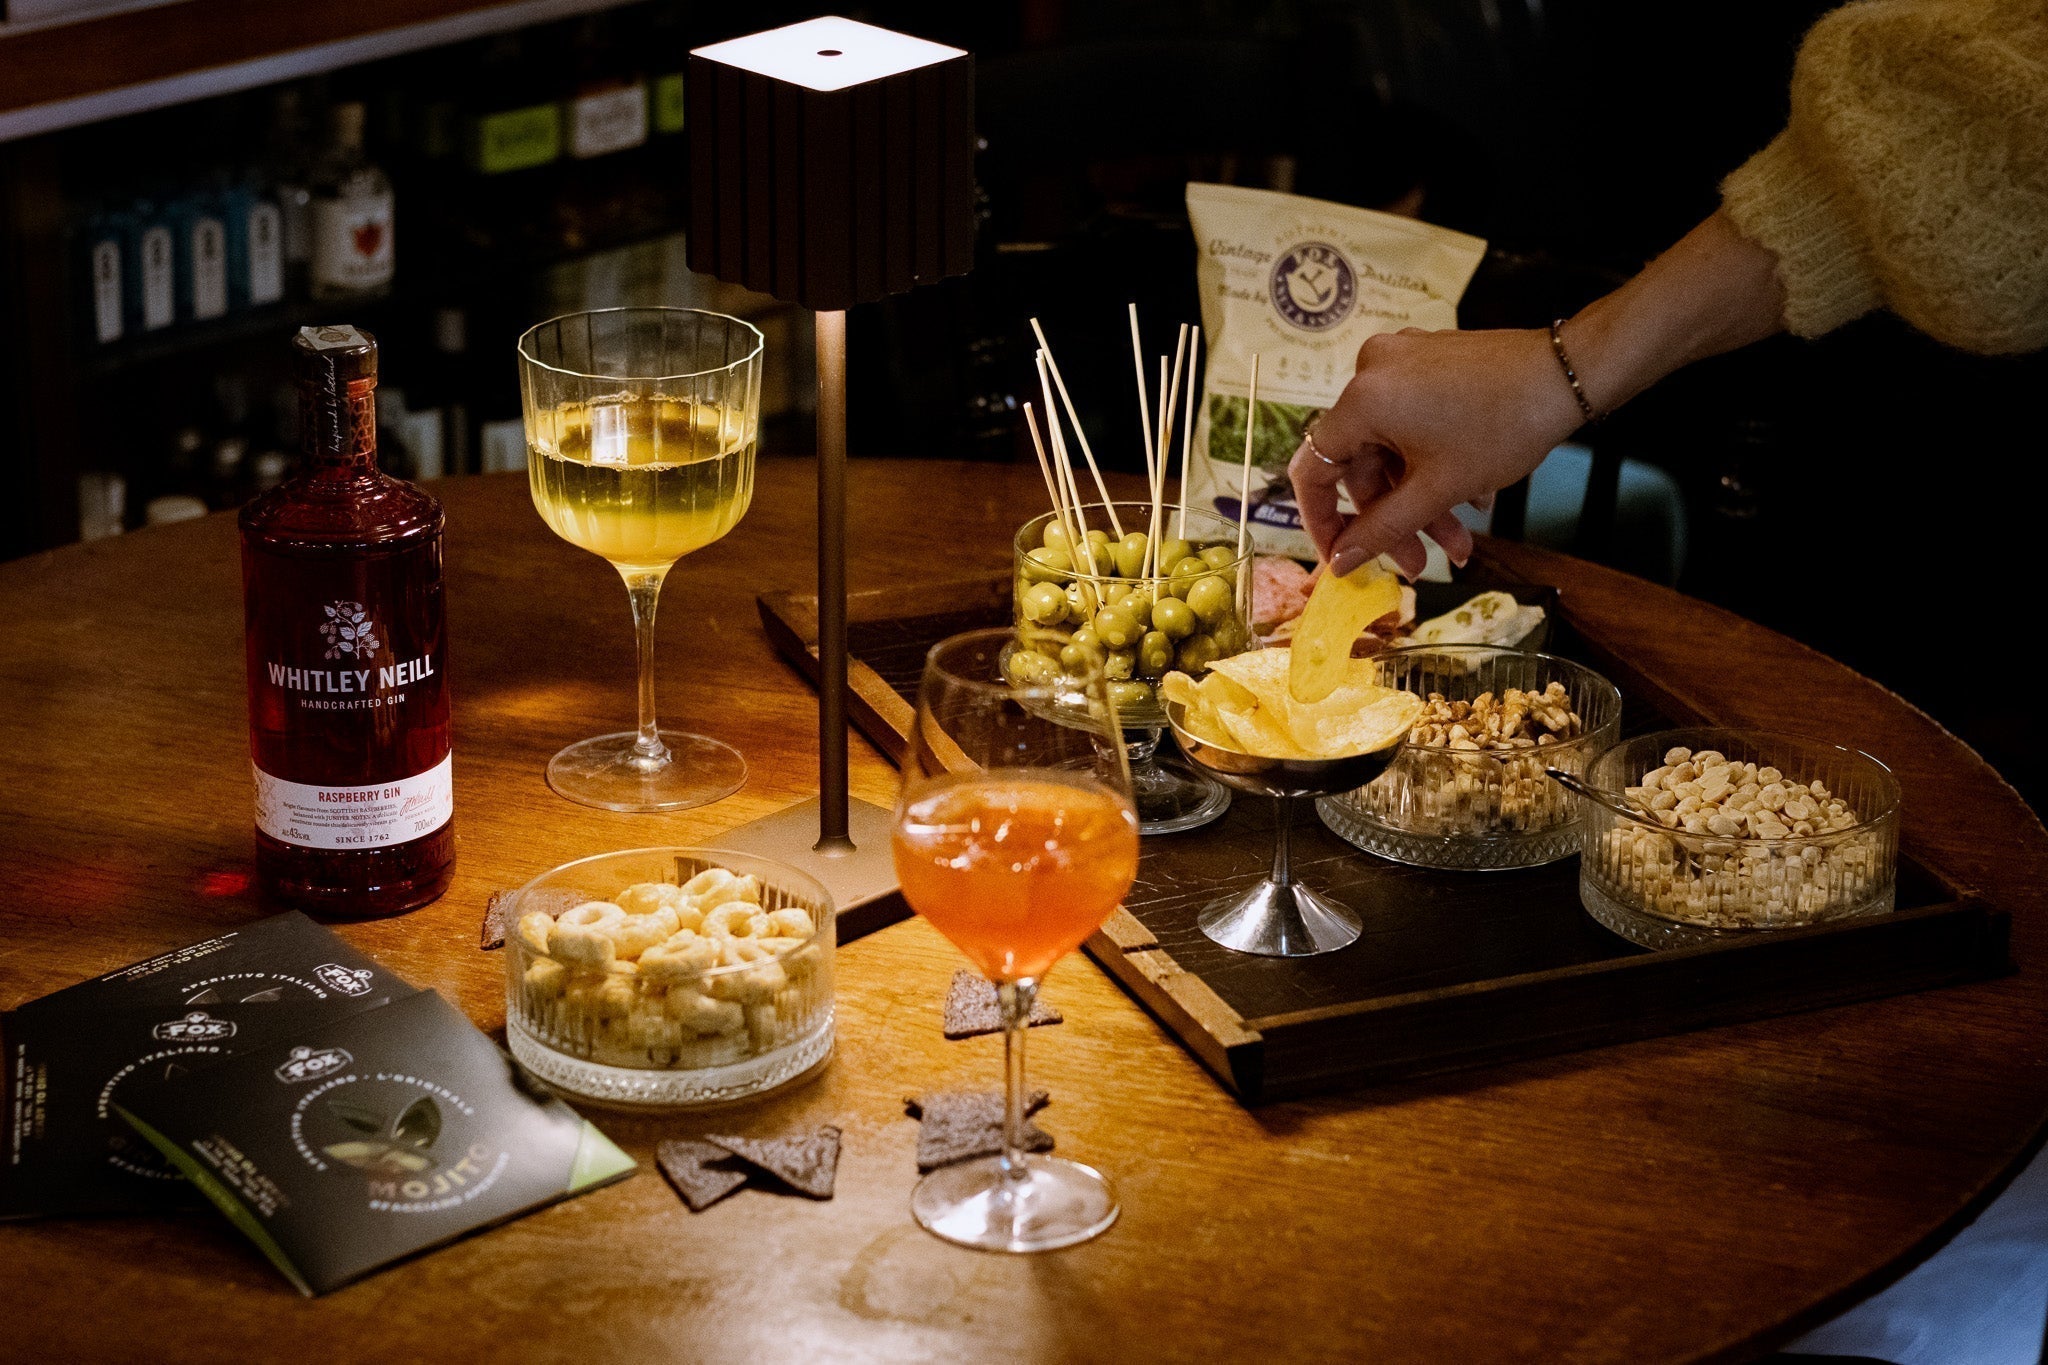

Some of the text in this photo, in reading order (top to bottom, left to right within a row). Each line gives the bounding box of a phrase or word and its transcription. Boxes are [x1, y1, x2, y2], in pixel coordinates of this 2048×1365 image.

[1209, 239, 1271, 264] Vintage
[322, 354, 336, 397] Scotland
[328, 410, 343, 453] Inspired
[268, 653, 435, 693] WHITLEY NEILL
[301, 693, 406, 711] HANDCRAFTED GIN
[318, 786, 401, 804] RASPBERRY GIN
[335, 833, 390, 844] SINCE 1762
[126, 941, 235, 983] READY TO DRINK
[176, 948, 197, 958] 100
[181, 972, 265, 994] APERITIVO
[271, 973, 329, 999] ITALIANO
[324, 968, 362, 991] FOX
[169, 1023, 222, 1037] FOX
[289, 1053, 340, 1078] FOX
[97, 1045, 220, 1119] APERITIVO ITALIANO
[36, 1091, 47, 1105] TO
[368, 1142, 490, 1200] MOJITO
